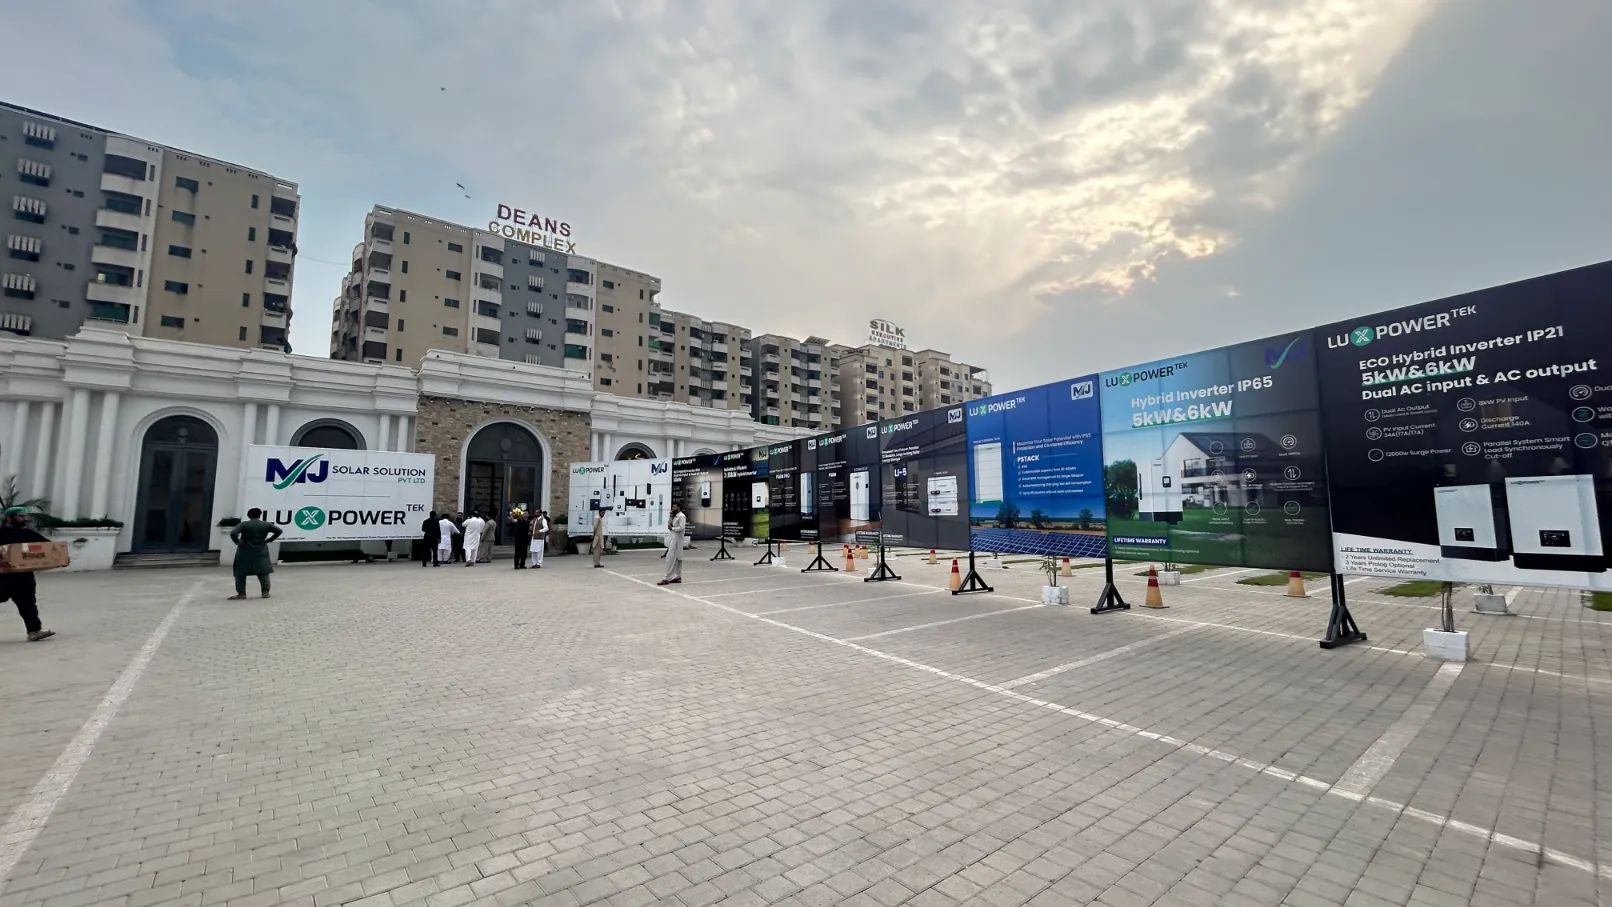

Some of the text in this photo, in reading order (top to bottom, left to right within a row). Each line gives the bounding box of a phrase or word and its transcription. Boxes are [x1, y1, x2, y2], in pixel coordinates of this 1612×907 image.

[497, 203, 571, 237] DEANS
[488, 220, 577, 255] COMPLEX
[869, 319, 906, 338] SILK
[1359, 325, 1564, 370] ECO Hybrid Inverter IP21
[1361, 355, 1477, 386] 5kW&6kW
[1362, 358, 1598, 400] Dual AC input & AC output
[1131, 375, 1273, 410] Hybrid Inverter IP65
[1507, 395, 1529, 403] Input
[1132, 400, 1233, 428] 5kW&6kW
[1406, 404, 1430, 412] Output
[1480, 415, 1520, 424] Discharge
[1481, 422, 1510, 430] Current
[1483, 435, 1571, 447] Parallel System Smart
[1504, 443, 1564, 454] Synchronously
[1484, 452, 1513, 460] Cut-off
[265, 455, 329, 488] MJ
[332, 465, 426, 477] SOLAR SOLUTION
[651, 462, 668, 476] MJ
[1135, 537, 1167, 545] WARRANTY
[1372, 547, 1413, 555] WARRANTY
[1398, 568, 1427, 577] Warranty
